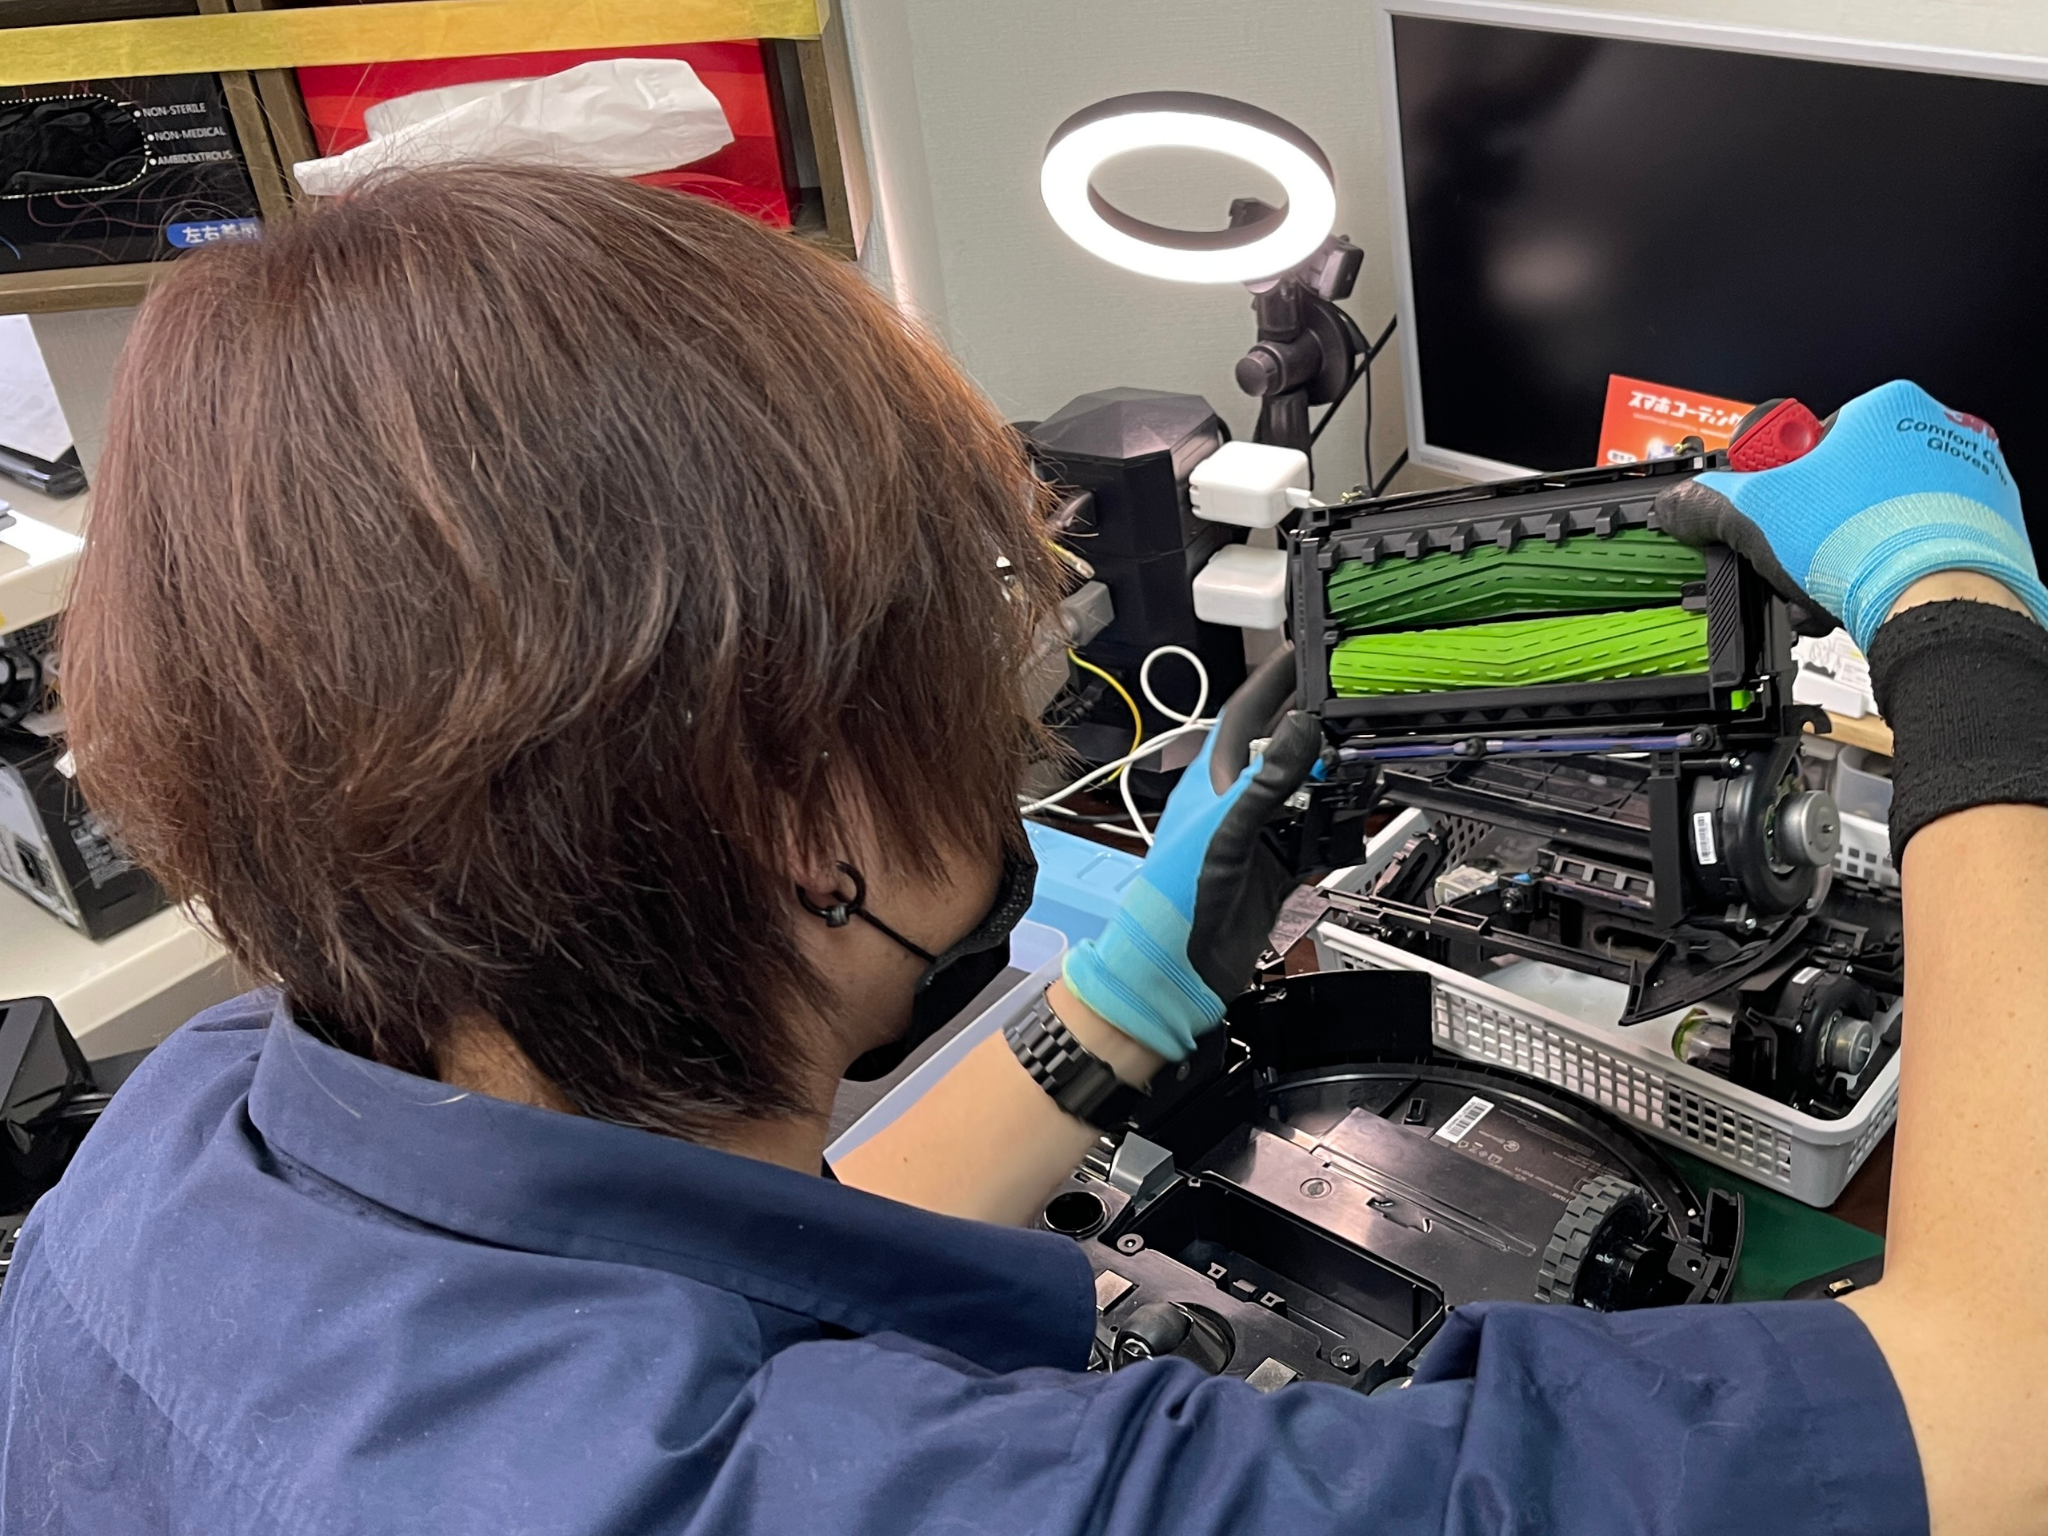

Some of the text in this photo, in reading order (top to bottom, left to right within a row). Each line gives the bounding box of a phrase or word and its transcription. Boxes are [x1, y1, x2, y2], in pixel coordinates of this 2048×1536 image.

[142, 103, 207, 117] NON-STERILE
[154, 127, 227, 141] NON-MEDICAL
[157, 150, 233, 165] AMBIDEXTROUS
[1896, 417, 1978, 454] Comfort
[1927, 437, 1989, 476] Gloves
